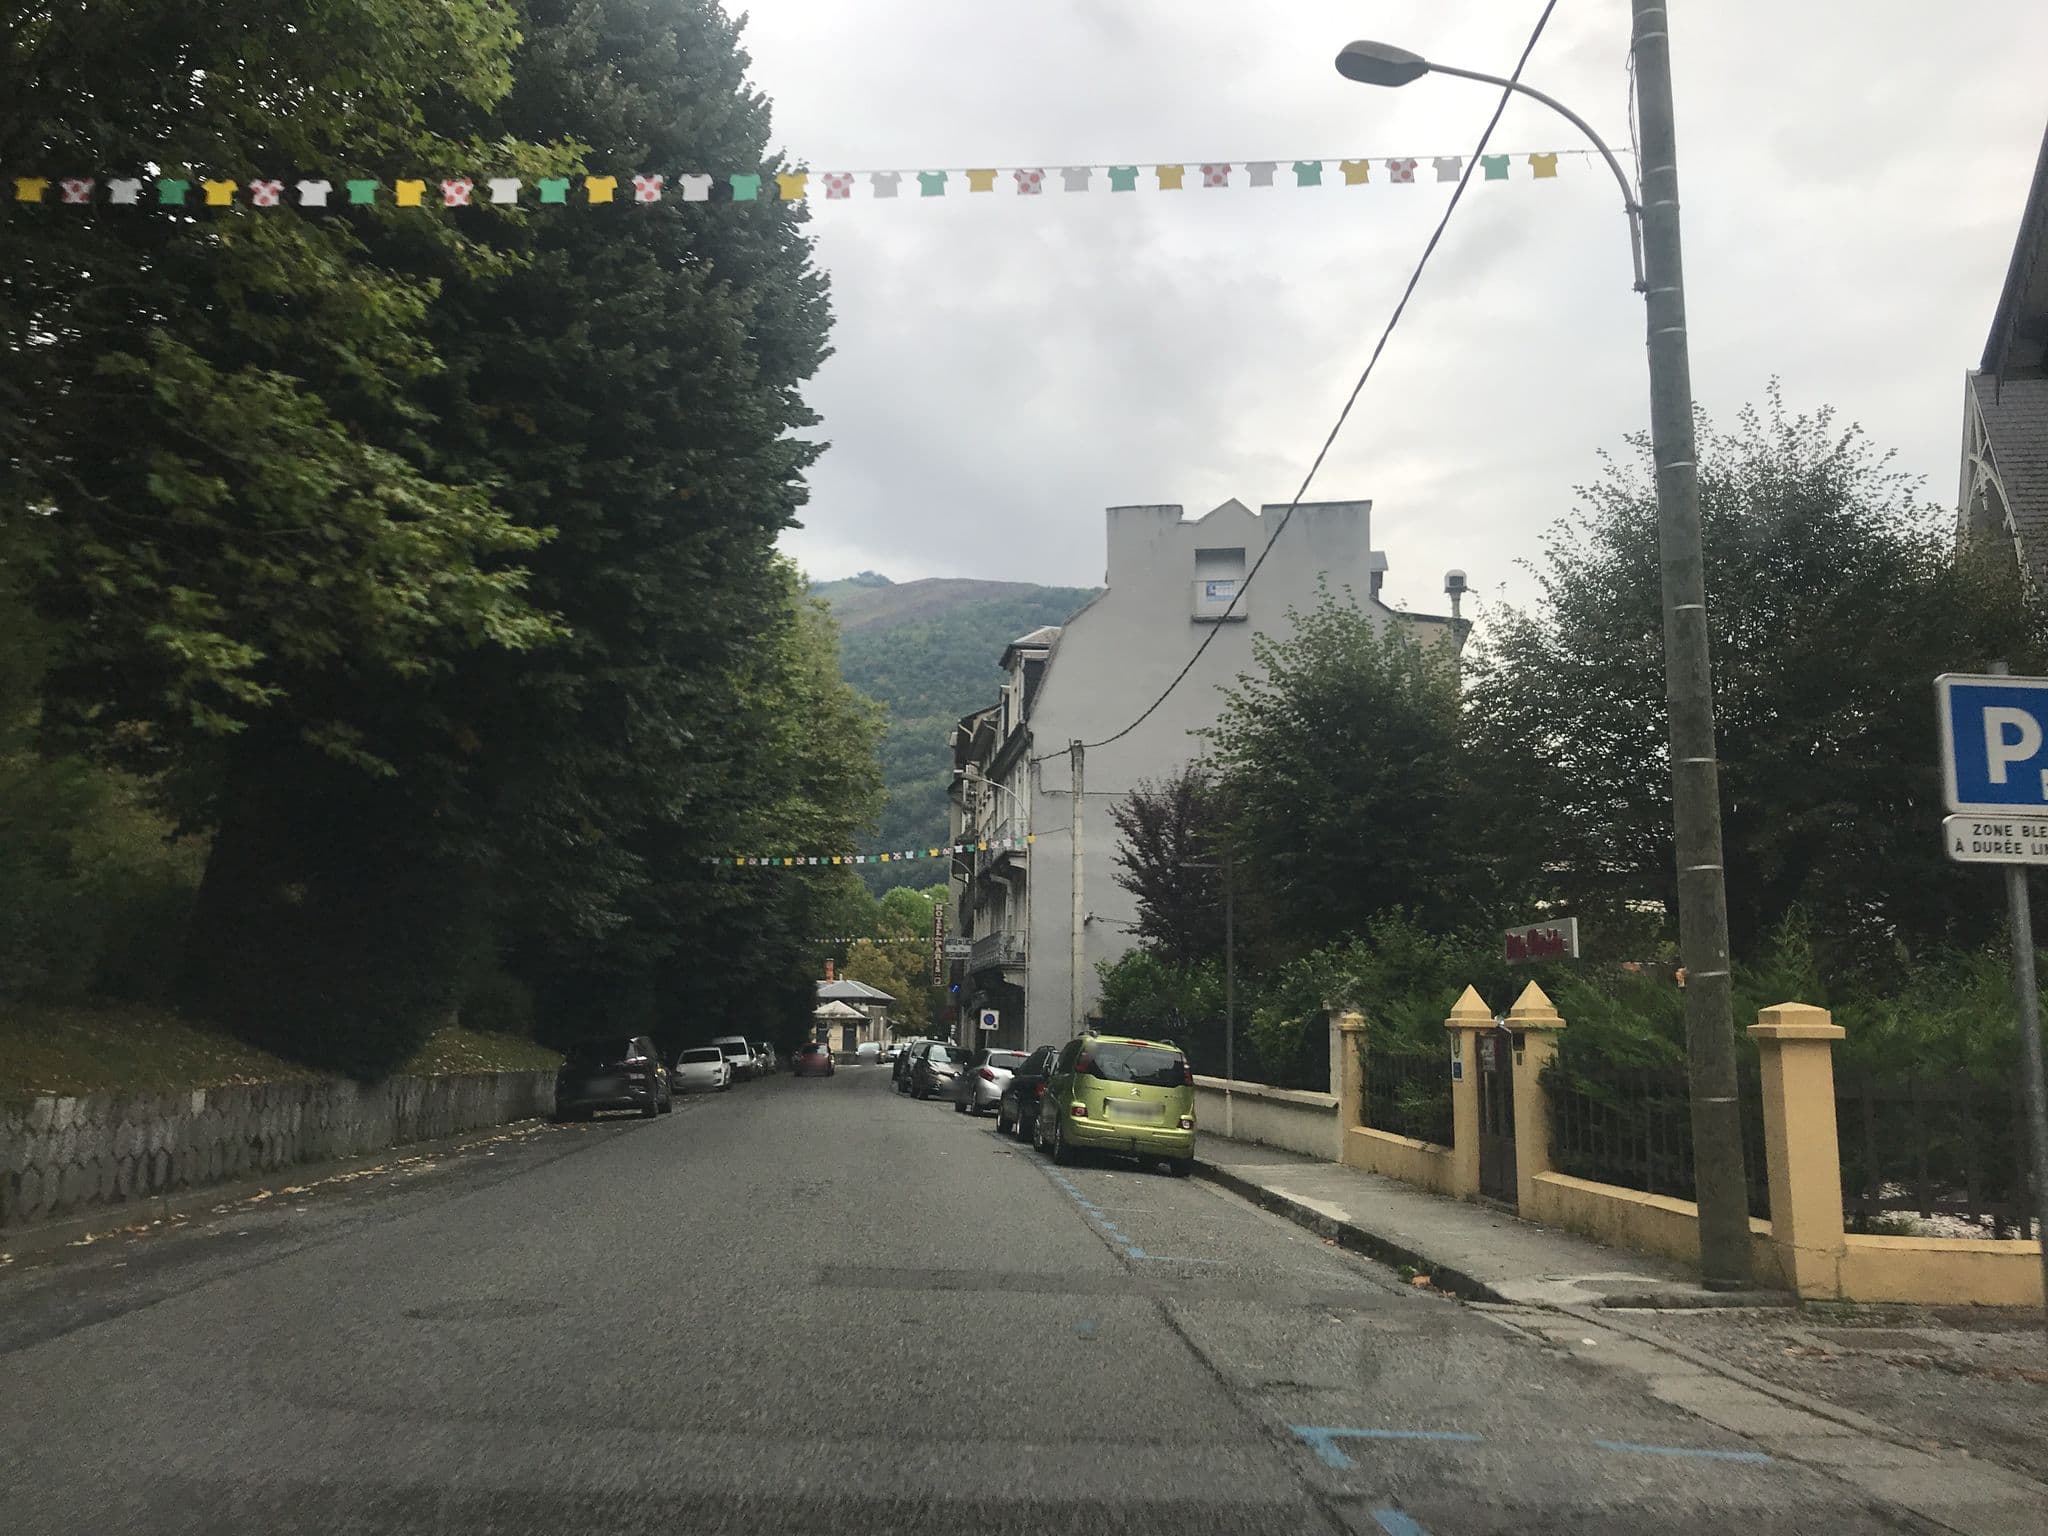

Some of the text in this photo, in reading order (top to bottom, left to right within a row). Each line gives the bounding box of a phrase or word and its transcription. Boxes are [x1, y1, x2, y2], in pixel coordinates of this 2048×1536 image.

[1983, 706, 2042, 784] P
[1972, 823, 2014, 837] ZONE
[1955, 838, 1965, 853] À
[1972, 839, 2023, 855] DURÉE
